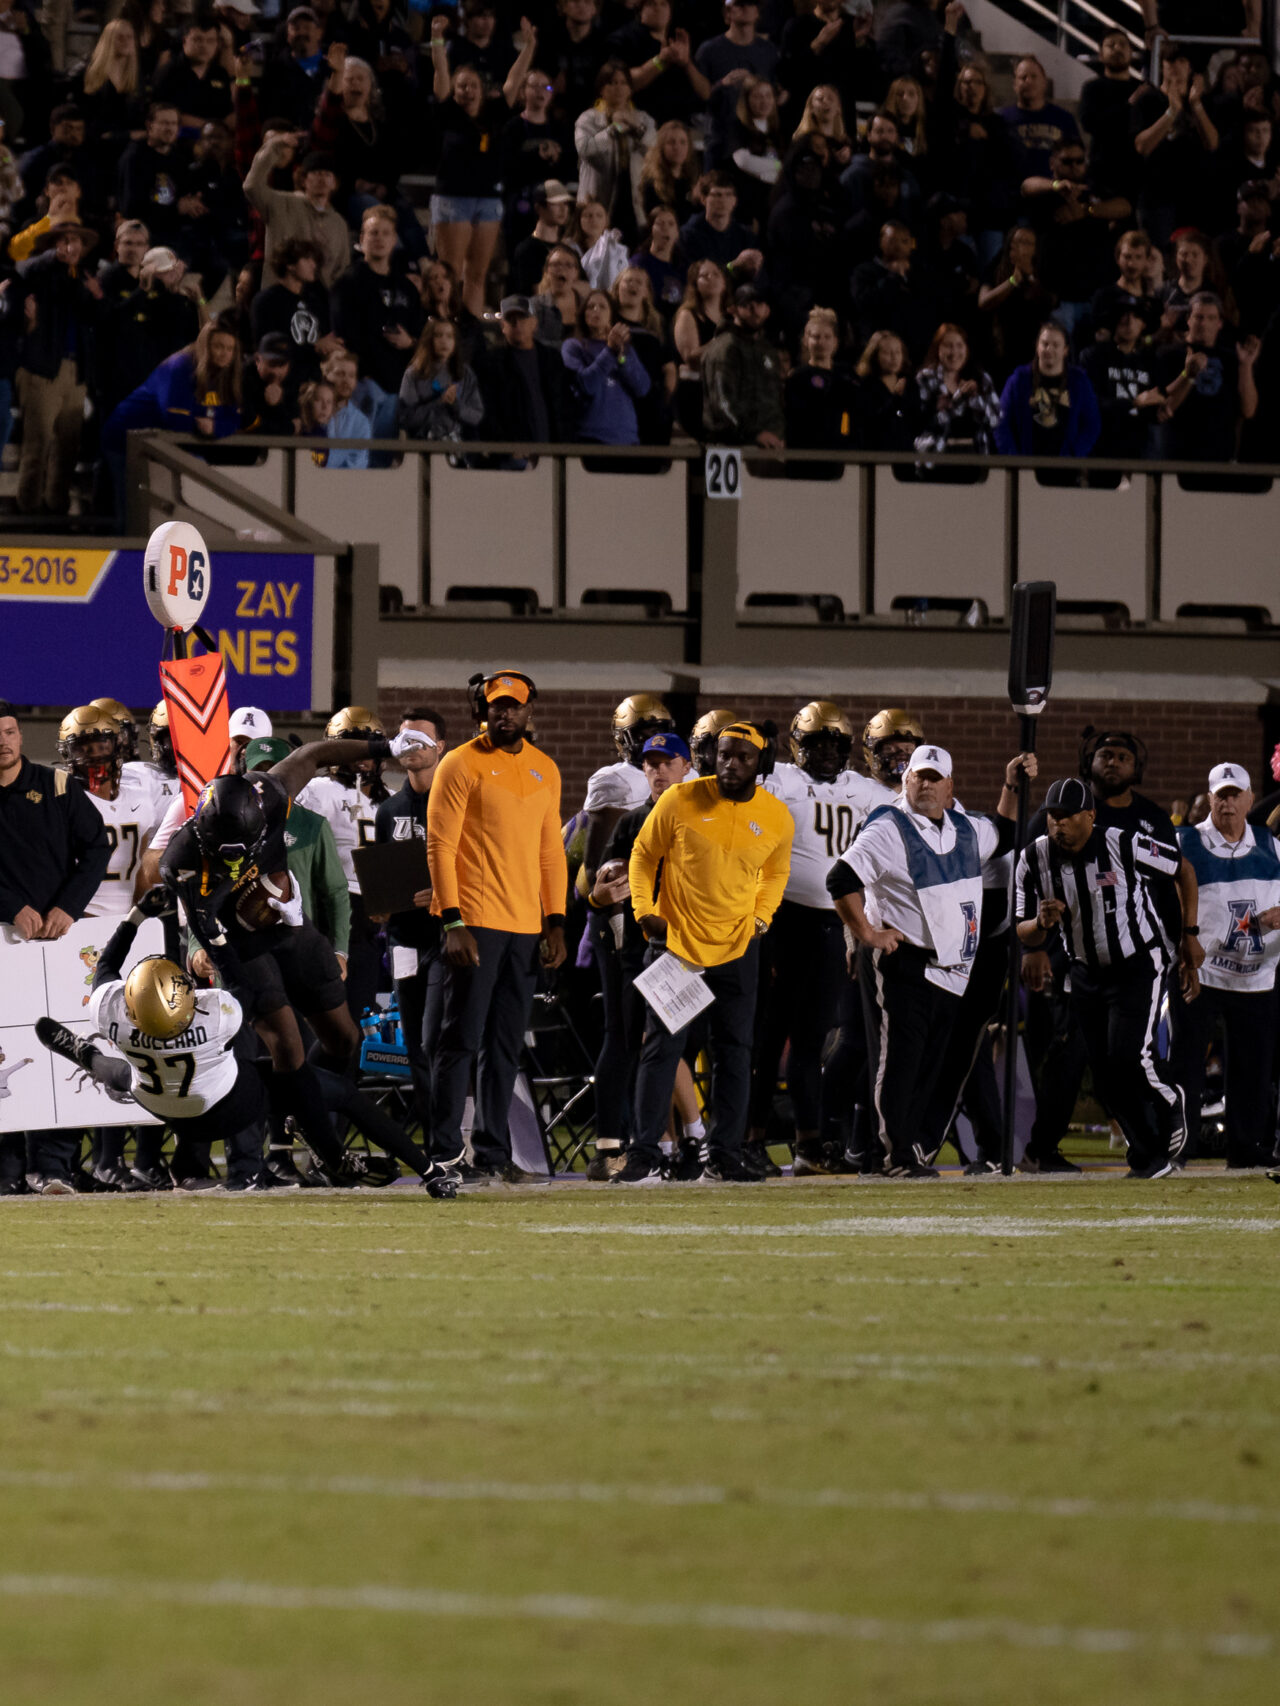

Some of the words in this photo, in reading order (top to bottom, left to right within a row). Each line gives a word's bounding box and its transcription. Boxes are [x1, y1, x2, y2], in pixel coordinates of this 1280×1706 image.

[708, 454, 739, 494] 20
[167, 544, 205, 601] P6
[235, 580, 301, 619] ZAY
[814, 801, 853, 857] 40
[1104, 900, 1117, 914] L
[125, 1050, 197, 1098] 37
[366, 1051, 409, 1065] POWERAD
